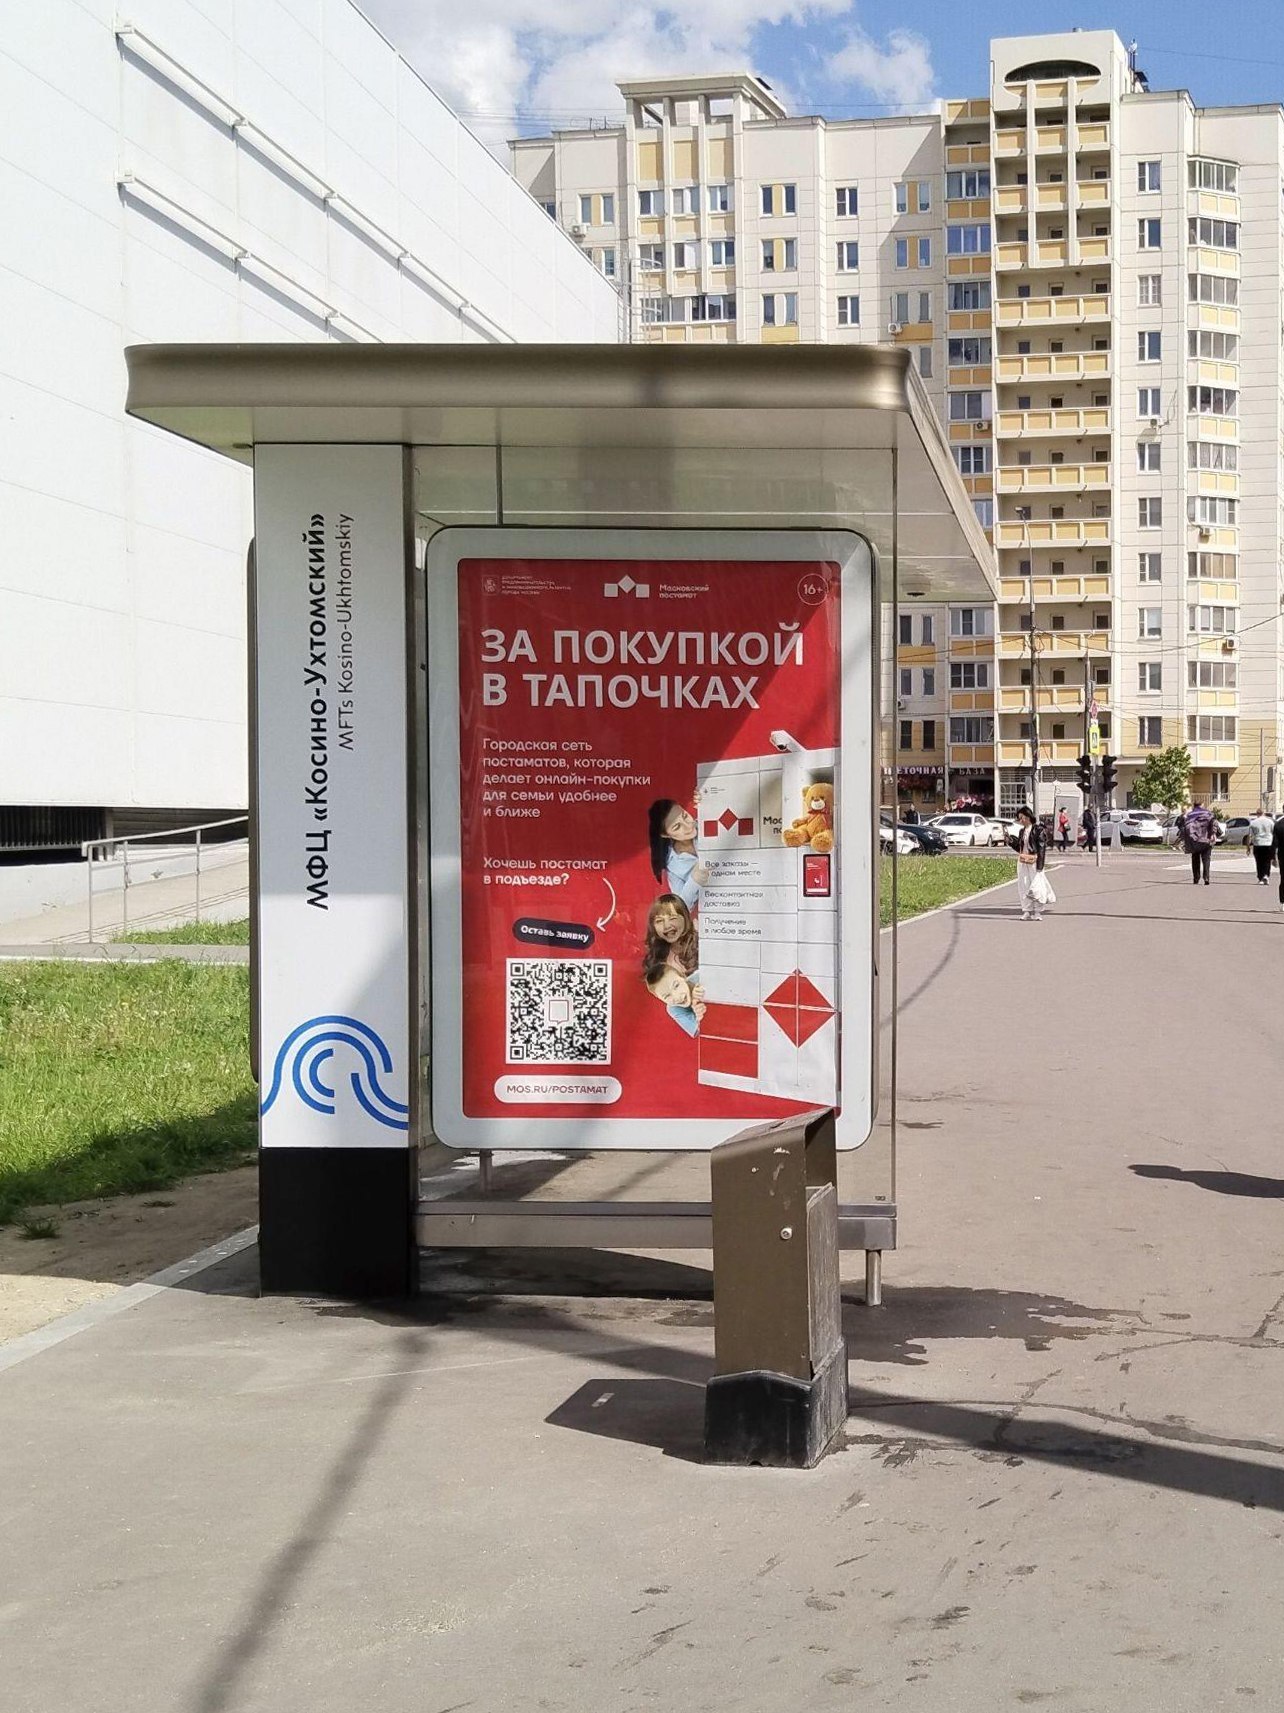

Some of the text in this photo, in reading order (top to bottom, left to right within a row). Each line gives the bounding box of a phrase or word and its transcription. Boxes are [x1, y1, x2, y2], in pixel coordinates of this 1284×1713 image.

[803, 583, 823, 595] 16+
[335, 513, 355, 751] MFTs Kosino-Ukhtomskiy
[481, 622, 804, 666] ЗА ПОКУПКОЙ
[482, 674, 760, 709] В ТАПОЧКАХ
[303, 513, 331, 910] МФЦ «Косино-Ухтомский»
[483, 738, 593, 752] Городская сеть
[483, 757, 631, 770] постаматов, которая
[483, 773, 651, 788] делает онлайн-покупки
[483, 790, 617, 803] для семьи удобнее
[483, 805, 541, 818] и ближе
[483, 857, 608, 870] Хочешь постамат
[483, 873, 570, 887] в подъезде?
[520, 925, 589, 944] Оставь заявку
[506, 1084, 608, 1095] MOS.RU/POSTAMAT
